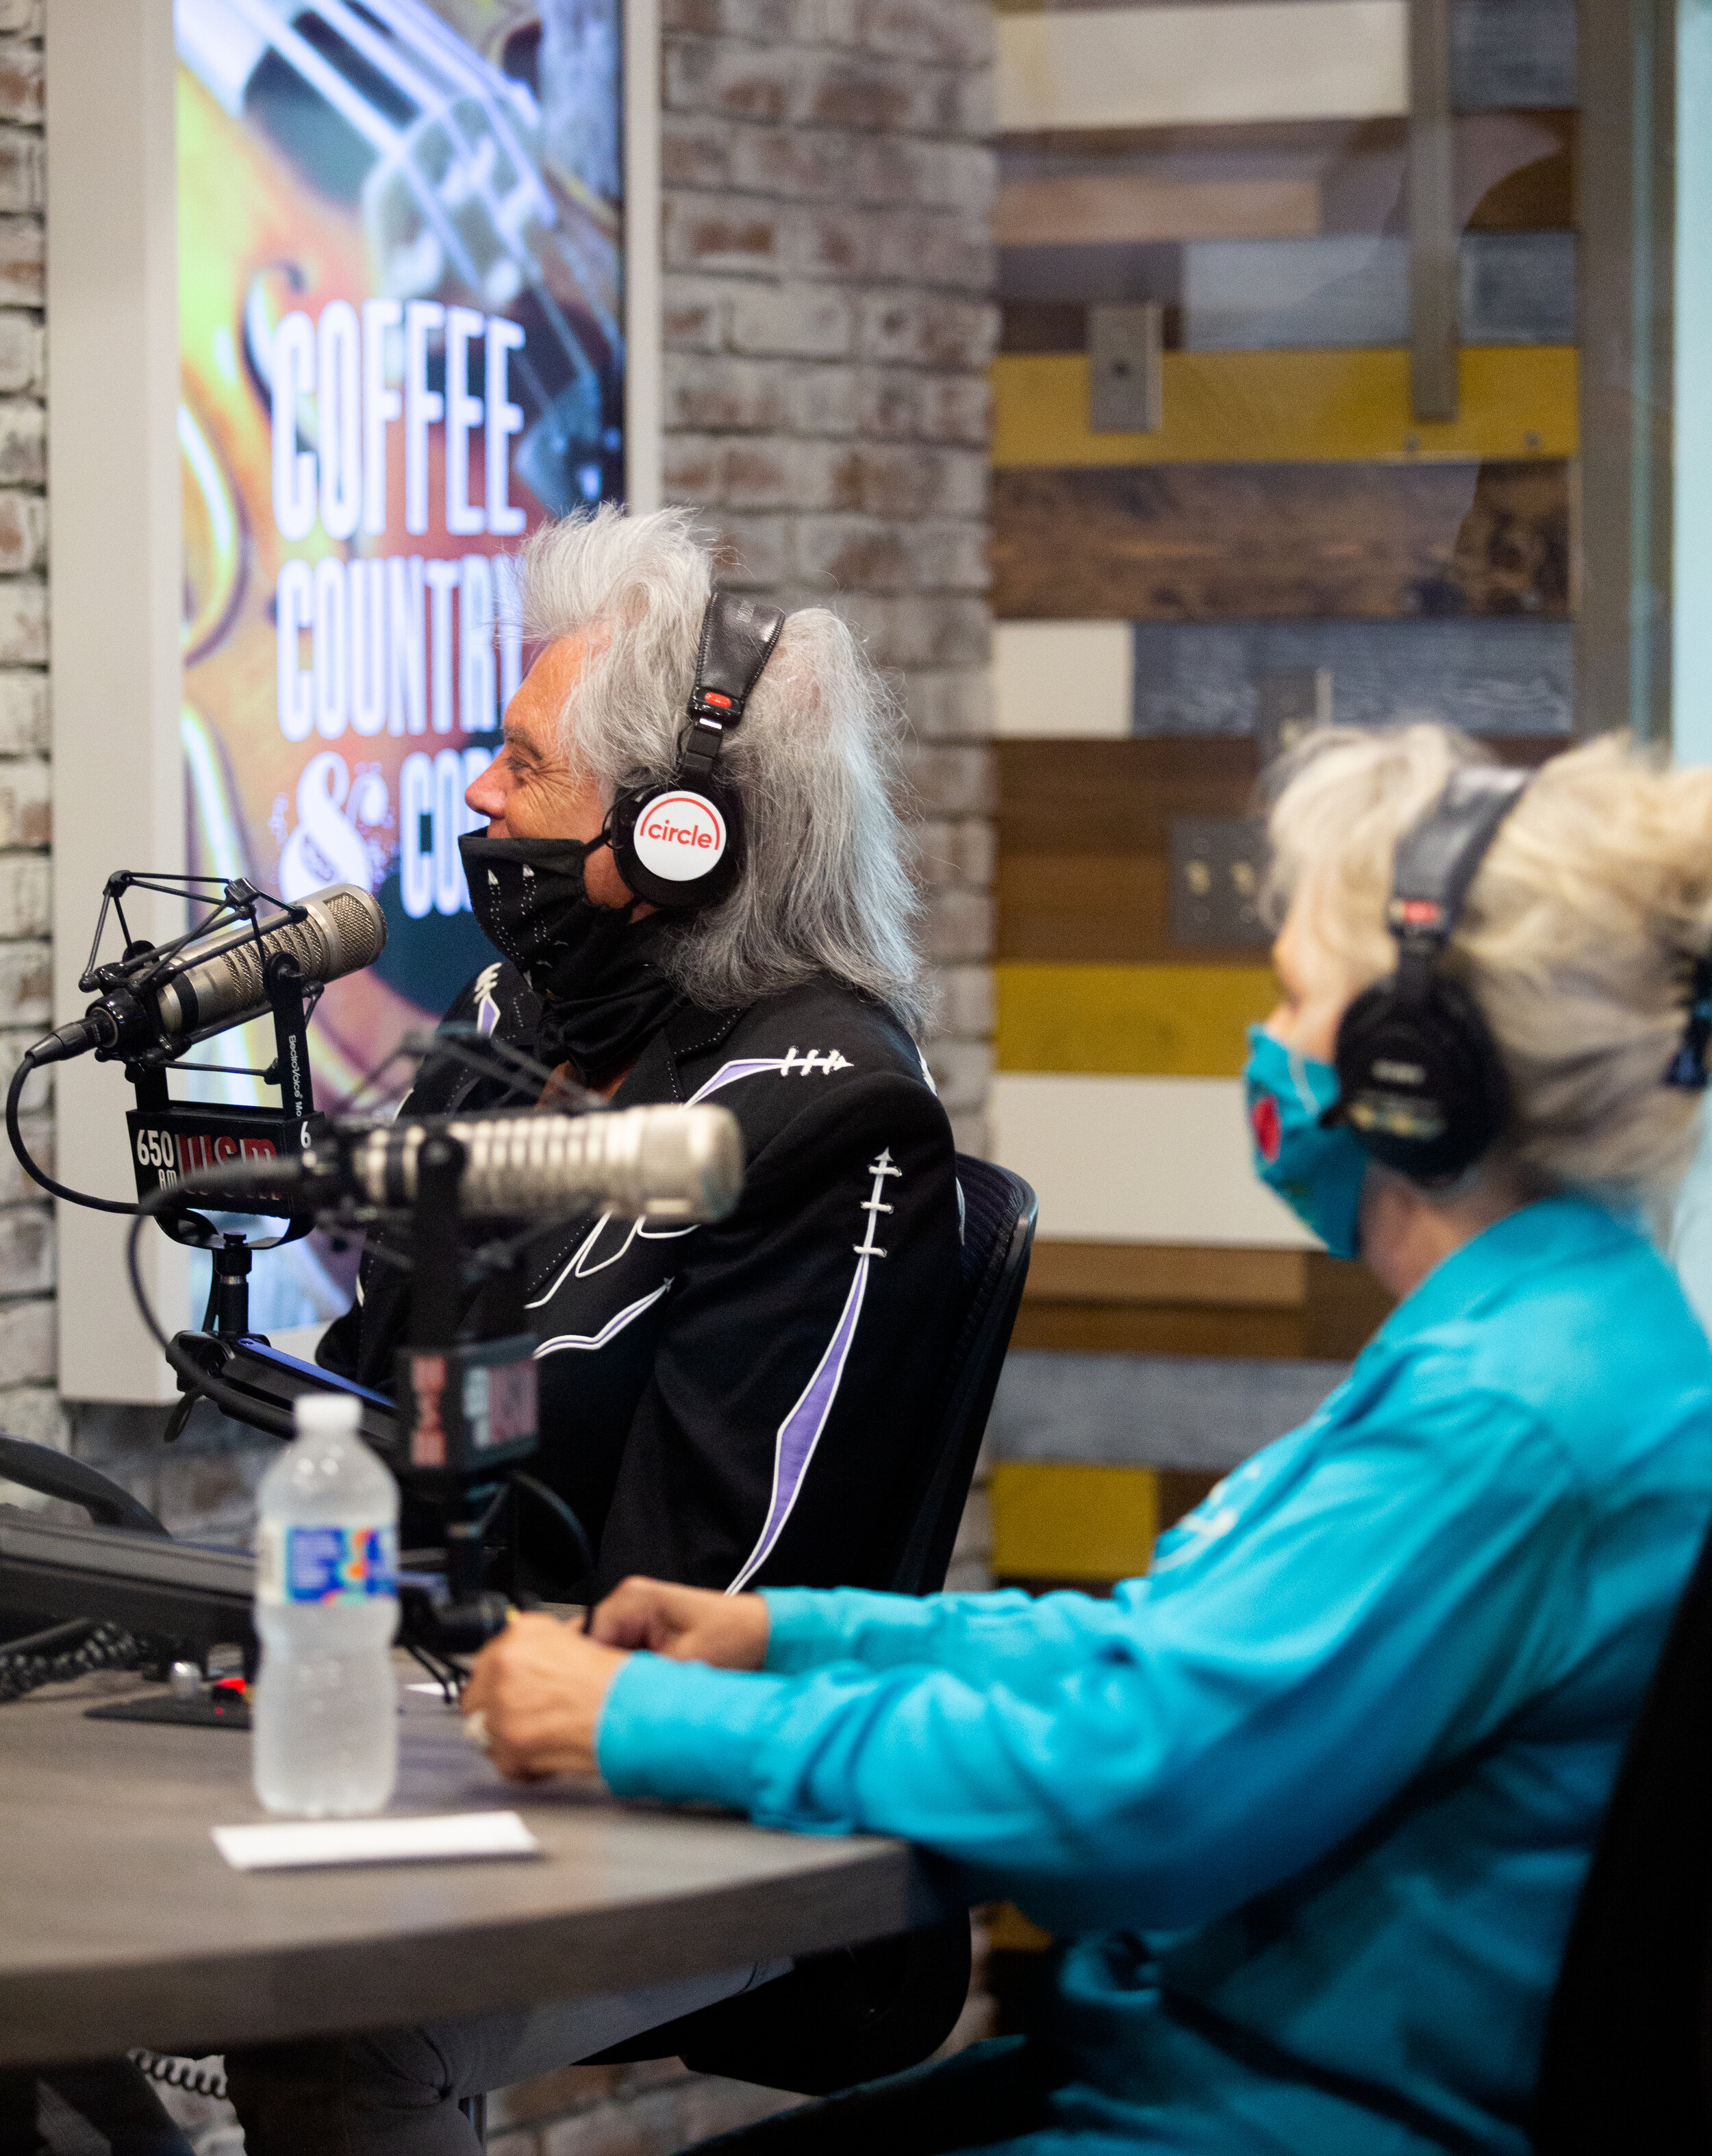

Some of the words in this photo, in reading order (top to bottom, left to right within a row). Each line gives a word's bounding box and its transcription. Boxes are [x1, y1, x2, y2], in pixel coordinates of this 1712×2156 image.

[273, 299, 527, 541] COFFEE
[277, 751, 389, 903] &
[648, 819, 712, 849] circle
[137, 1129, 175, 1168] 650
[158, 1168, 179, 1192] AM
